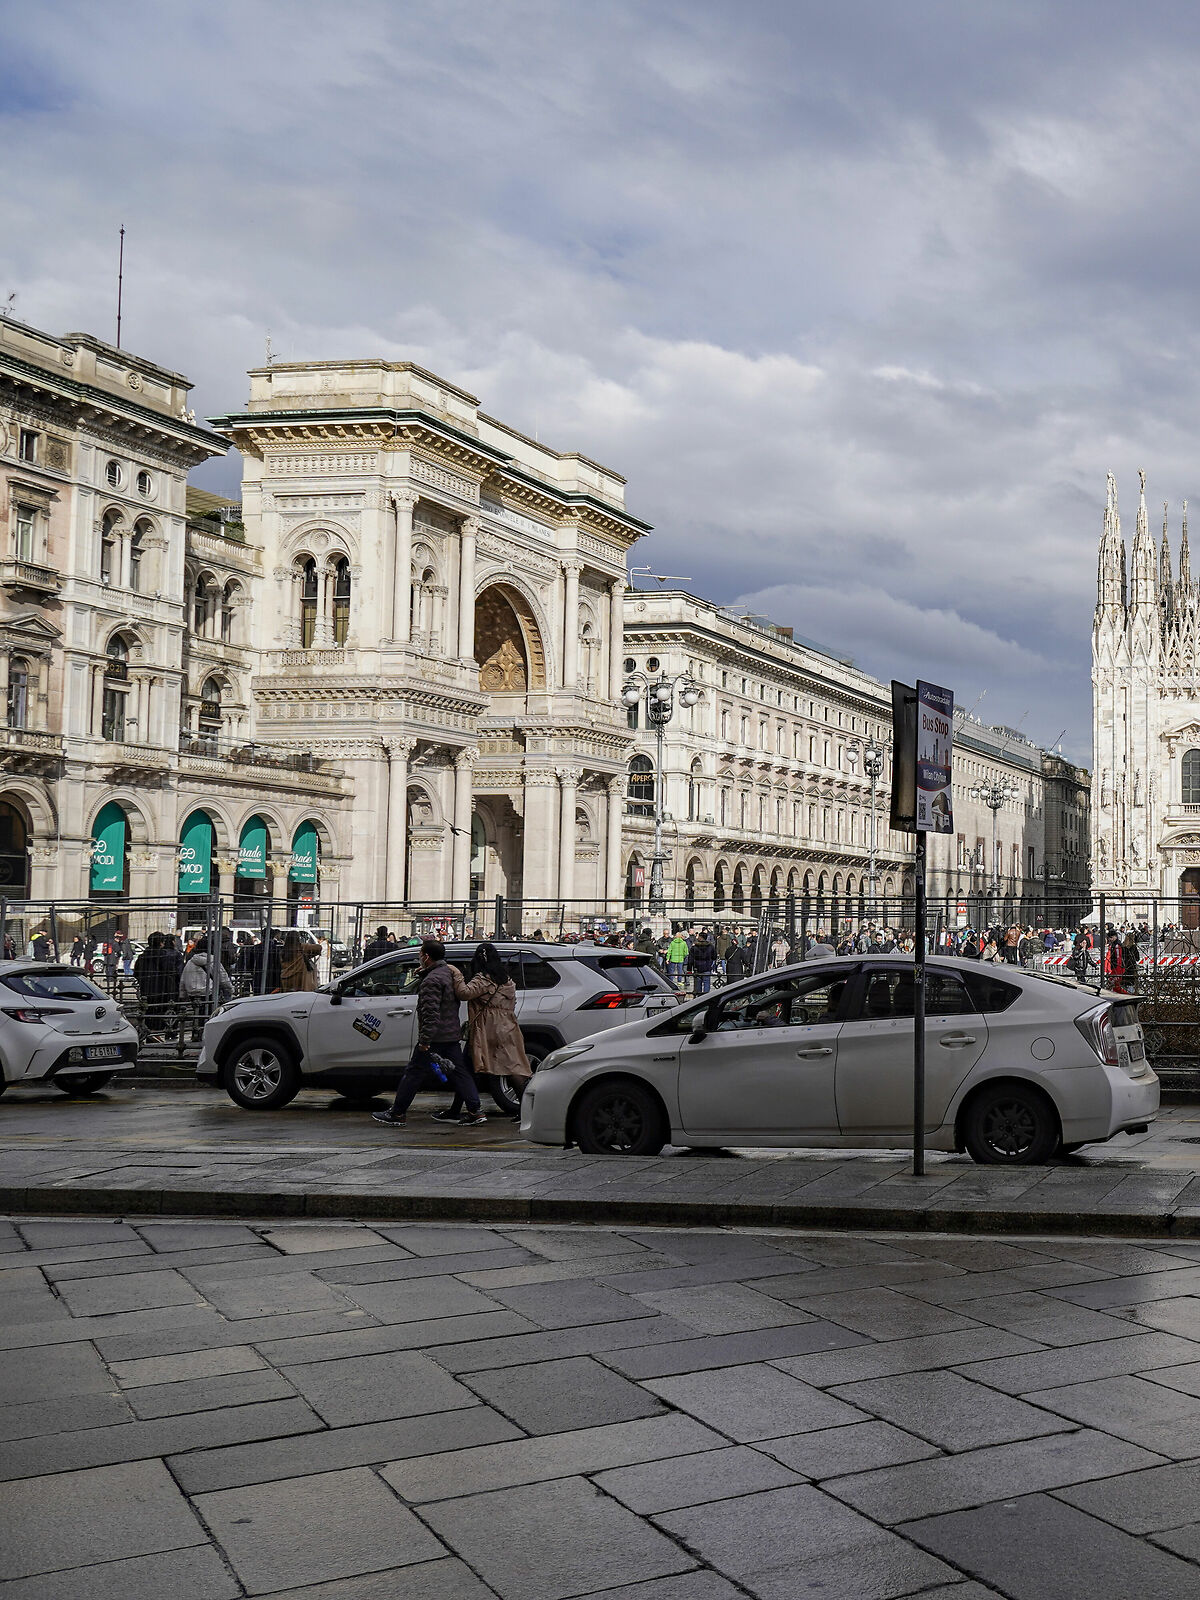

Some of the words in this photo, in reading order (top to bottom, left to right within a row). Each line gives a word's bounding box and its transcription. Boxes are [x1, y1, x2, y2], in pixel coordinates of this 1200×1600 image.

[922, 713, 934, 732] Bus
[934, 717, 949, 740] Stop
[636, 871, 644, 883] M
[364, 1013, 382, 1028] 4040
